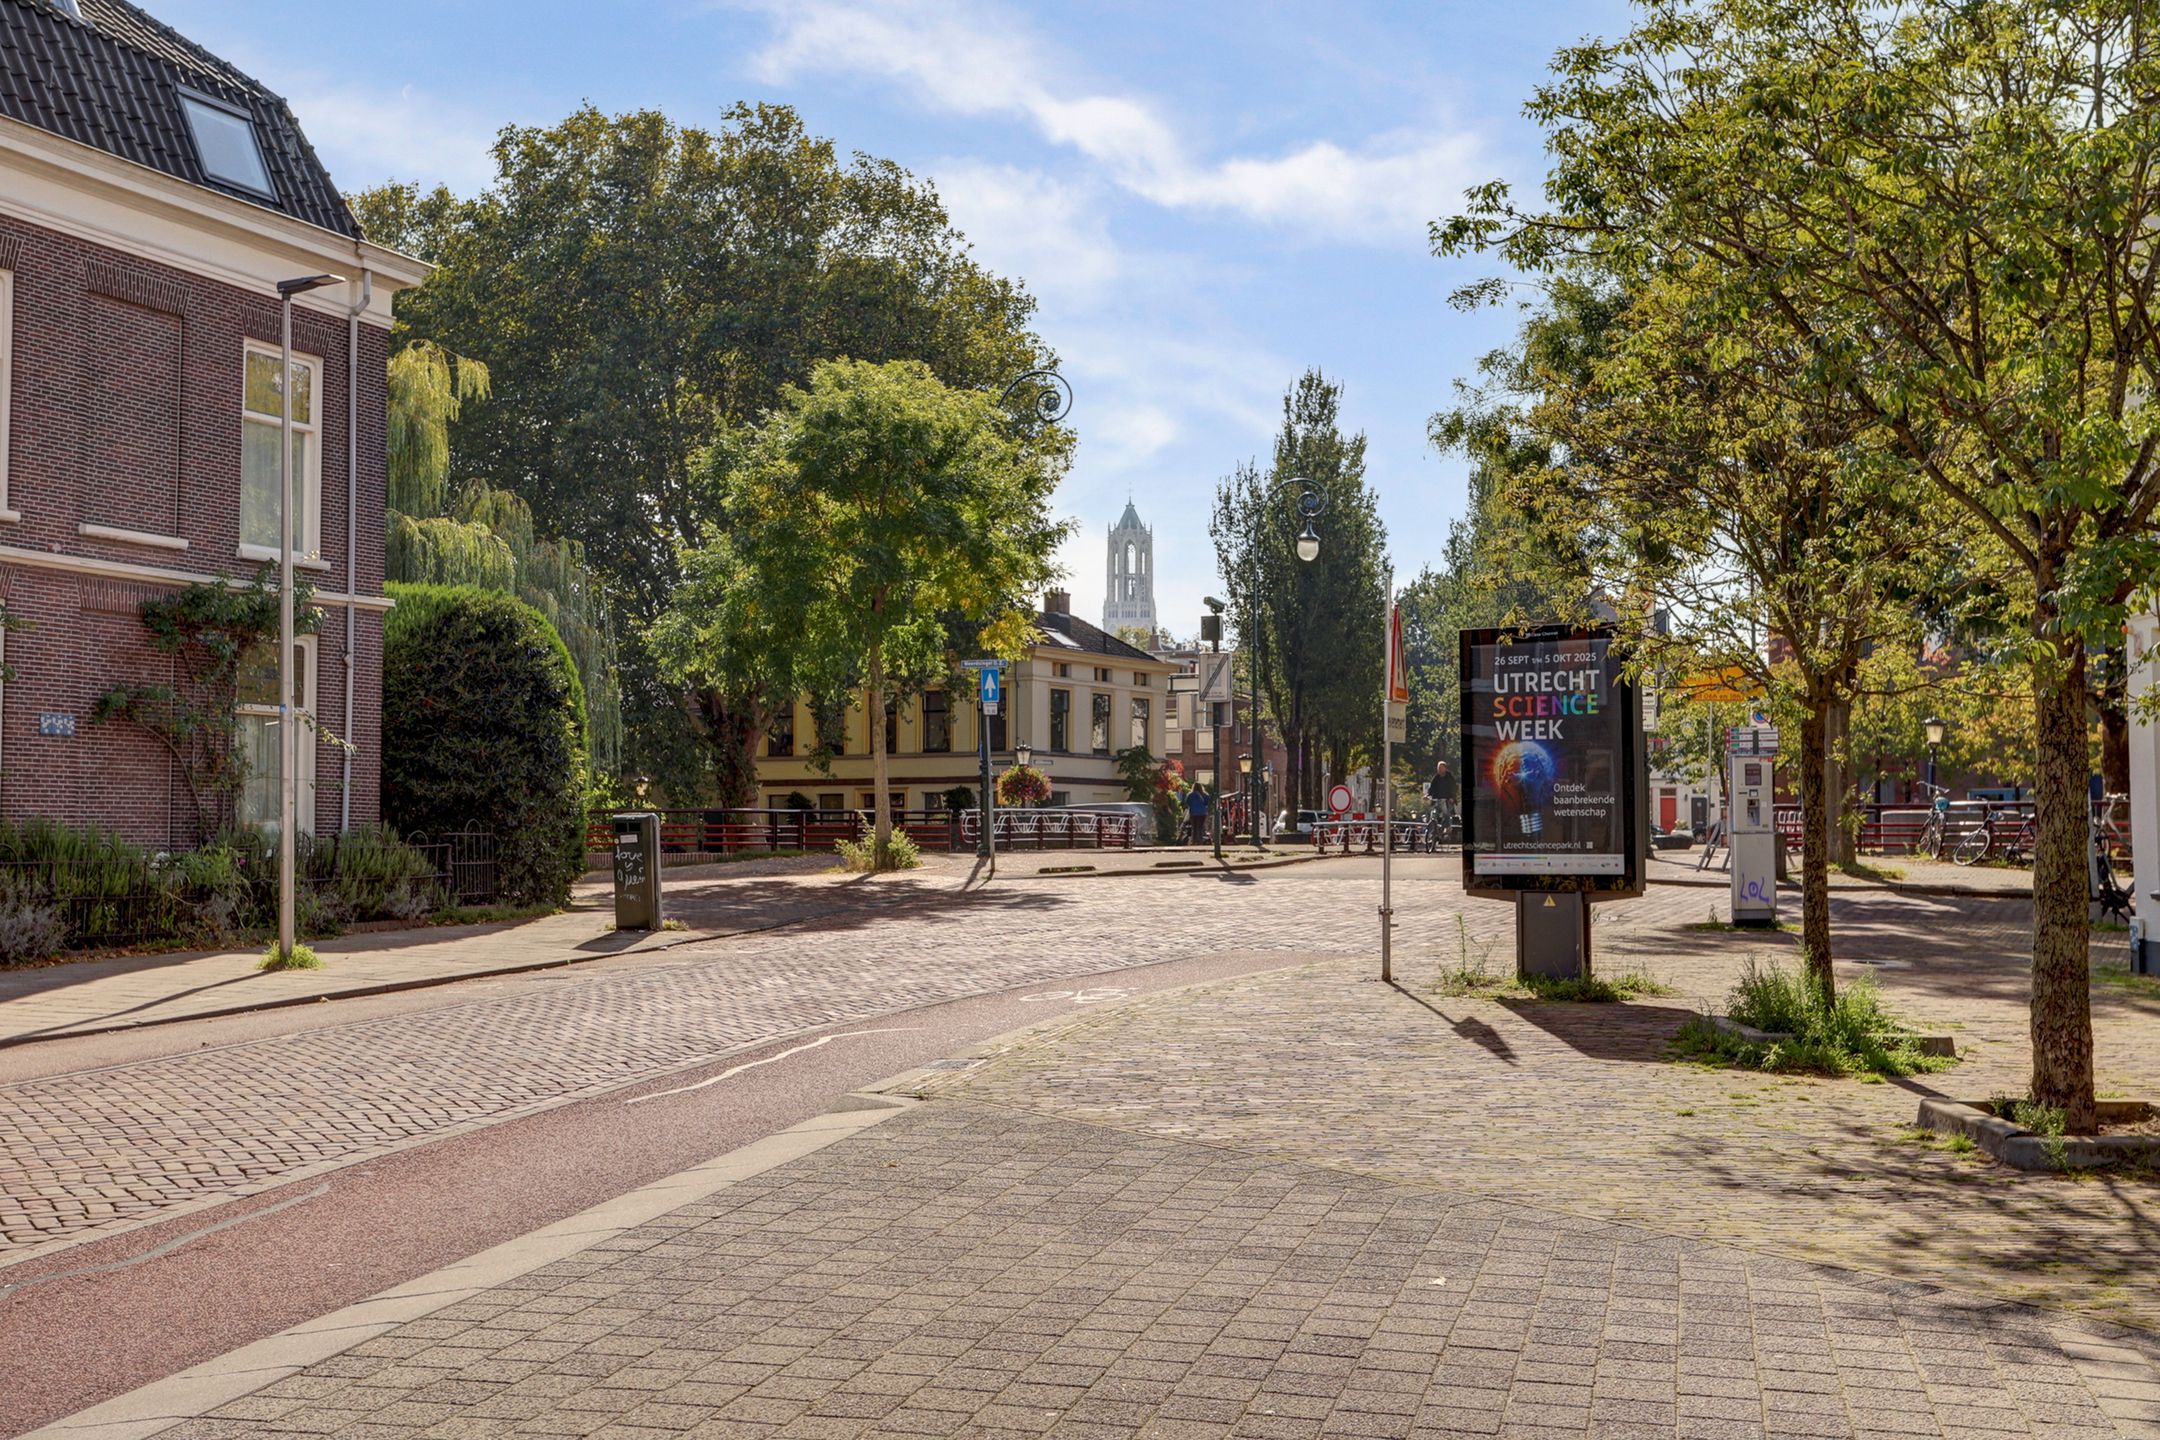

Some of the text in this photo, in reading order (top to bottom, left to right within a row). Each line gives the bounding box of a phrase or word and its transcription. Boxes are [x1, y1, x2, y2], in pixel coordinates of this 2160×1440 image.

[1494, 656, 1506, 666] 26
[1508, 655, 1529, 665] SEPT
[1545, 654, 1550, 664] 5
[1553, 653, 1572, 663] OKT
[1574, 652, 1597, 662] 2025
[1493, 669, 1600, 694] UTRECHT
[1493, 693, 1599, 718] SCIENCE
[1495, 719, 1564, 741] WEEK
[1553, 783, 1586, 793] Ontdek
[1553, 795, 1615, 805] baanbrekende
[1553, 808, 1607, 818] wetenschap
[1503, 841, 1581, 850] utrechtsciencepark.nl
